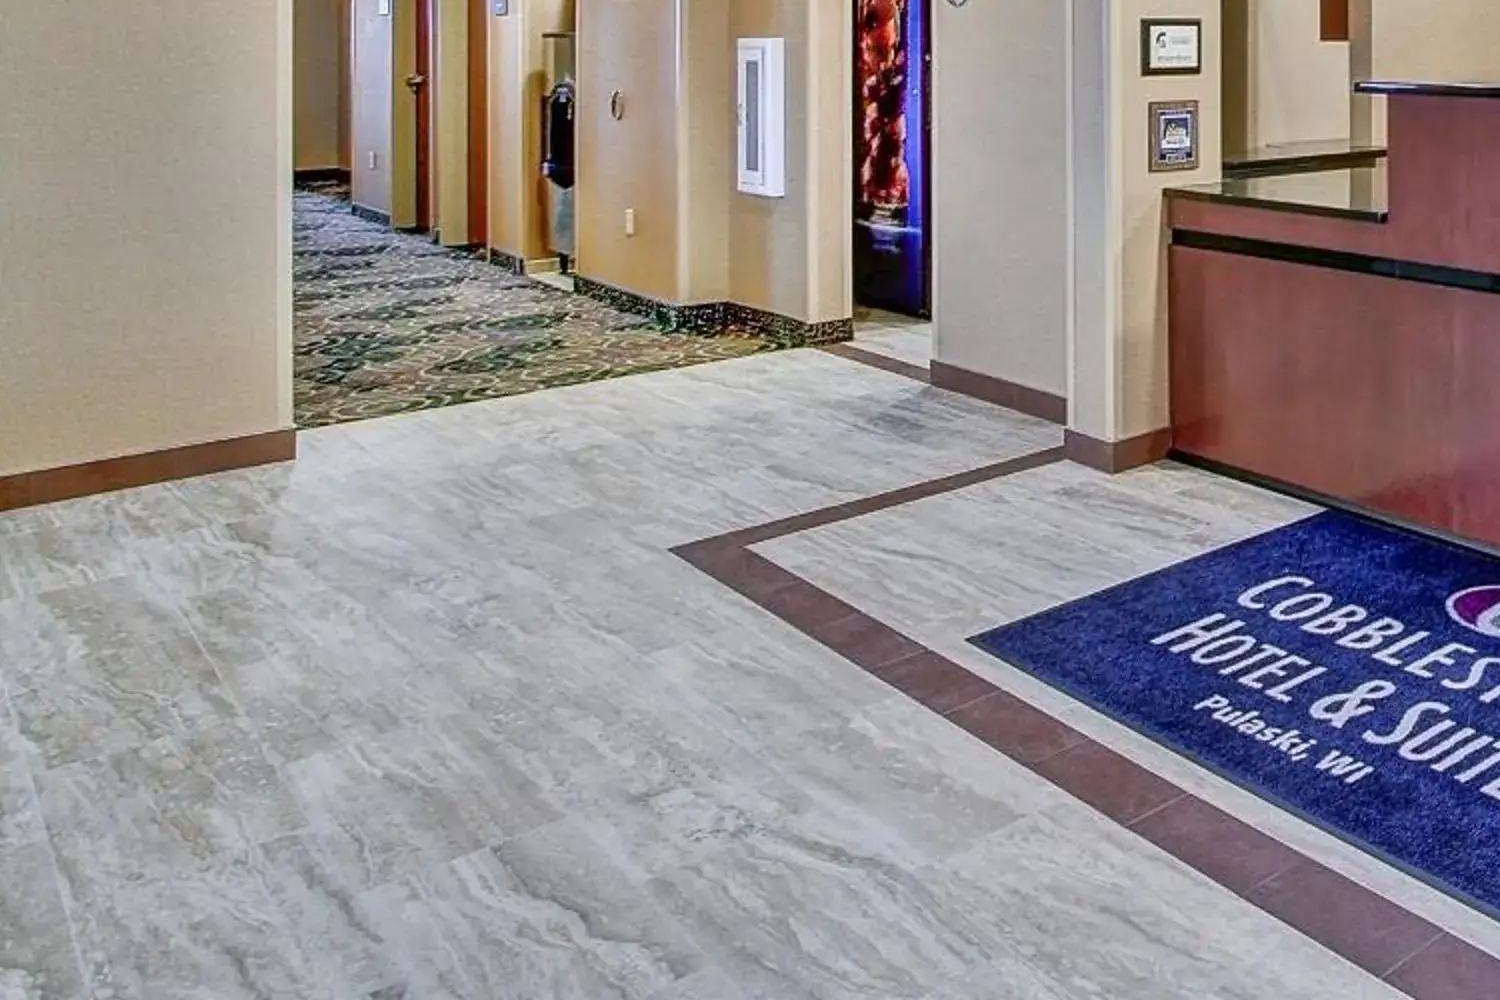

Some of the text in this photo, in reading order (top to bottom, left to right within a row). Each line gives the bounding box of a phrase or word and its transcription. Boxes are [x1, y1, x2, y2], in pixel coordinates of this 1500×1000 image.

[1150, 612, 1328, 702] HOTEL
[1310, 679, 1396, 729] &
[1193, 694, 1376, 784] Pulaski, WI
